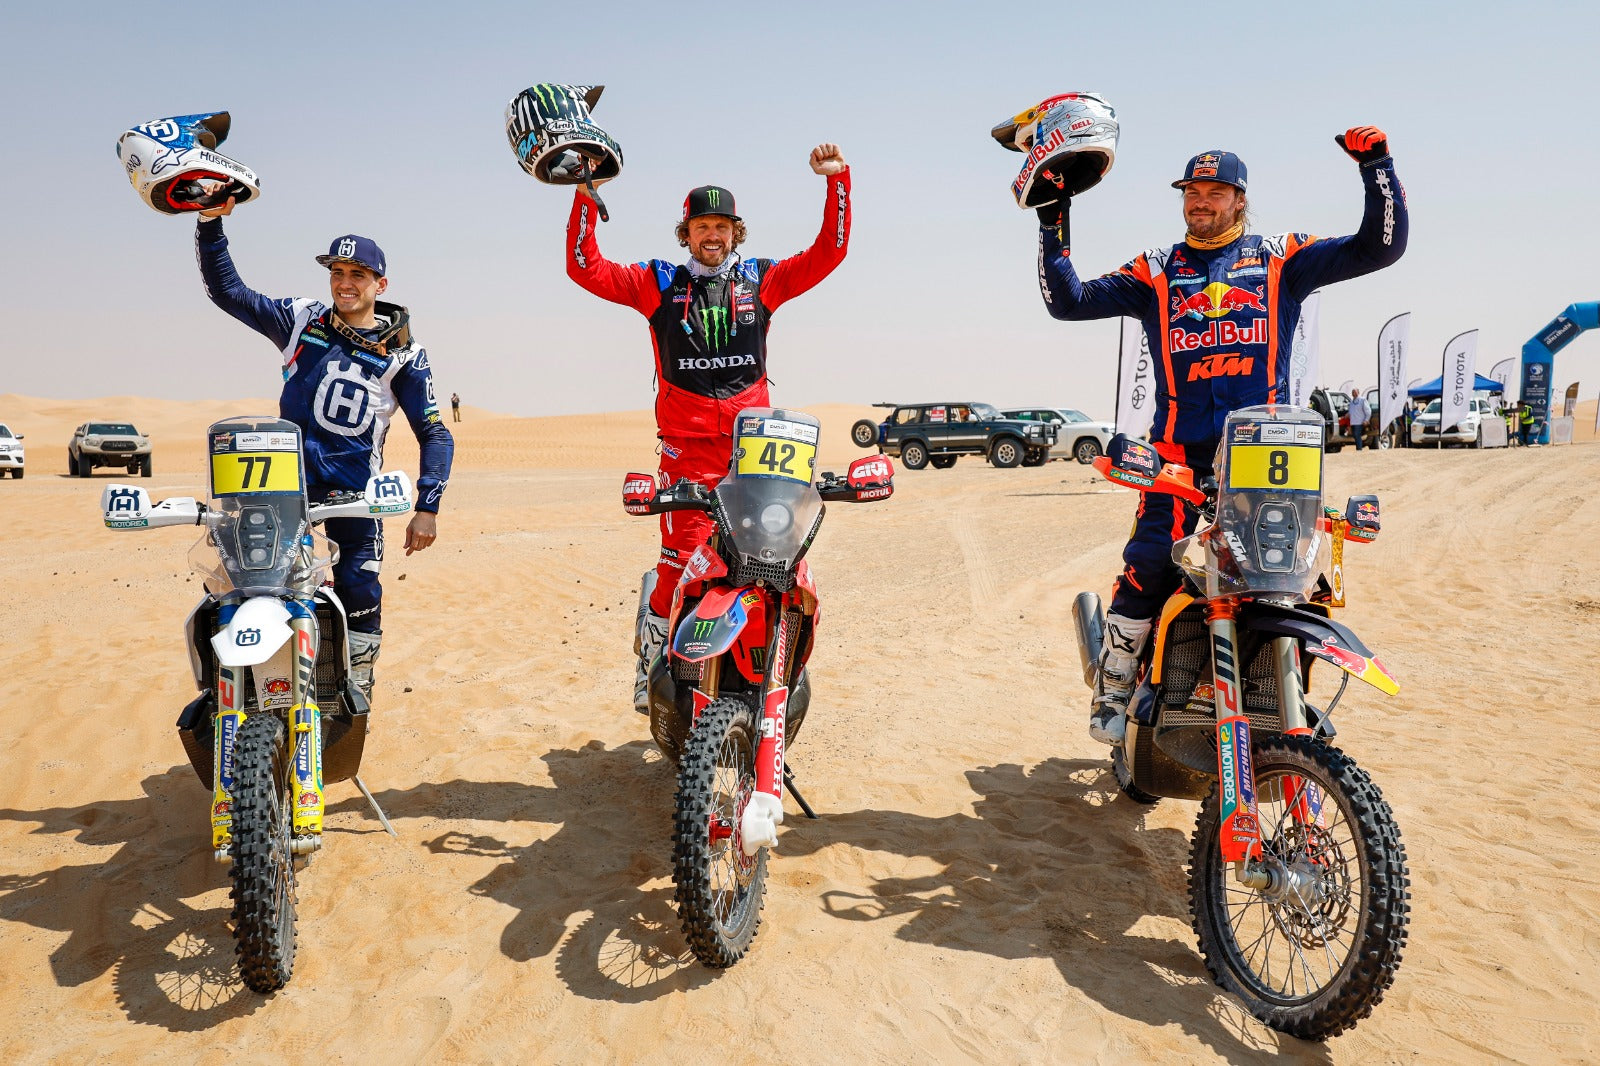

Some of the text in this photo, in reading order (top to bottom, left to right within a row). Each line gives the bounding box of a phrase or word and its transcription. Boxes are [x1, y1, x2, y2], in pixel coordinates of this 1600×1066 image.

[1071, 119, 1092, 131] BELL
[200, 150, 253, 180] Husqvarna
[1015, 128, 1066, 190] Red Bull
[1170, 317, 1268, 354] Red Bull
[678, 354, 757, 370] HONDA
[1187, 352, 1255, 382] KTM
[1455, 351, 1466, 390] TOYOTA
[237, 456, 272, 489] 77
[758, 441, 796, 475] 42
[851, 461, 889, 478] GIVI
[1121, 452, 1154, 469] Red Bull
[1268, 450, 1289, 486] 8
[623, 479, 652, 495] GIVI
[860, 487, 890, 499] MOTUL
[1120, 473, 1154, 487] MOTOREX
[380, 502, 411, 513] MOTOREX
[624, 504, 648, 513] MOTUL
[111, 519, 147, 528] MOTOREX
[223, 719, 234, 779] MICHELIN
[772, 701, 786, 793] HONDA
[1240, 726, 1252, 793] MICHELIN
[1221, 743, 1237, 806] MOTOREX
